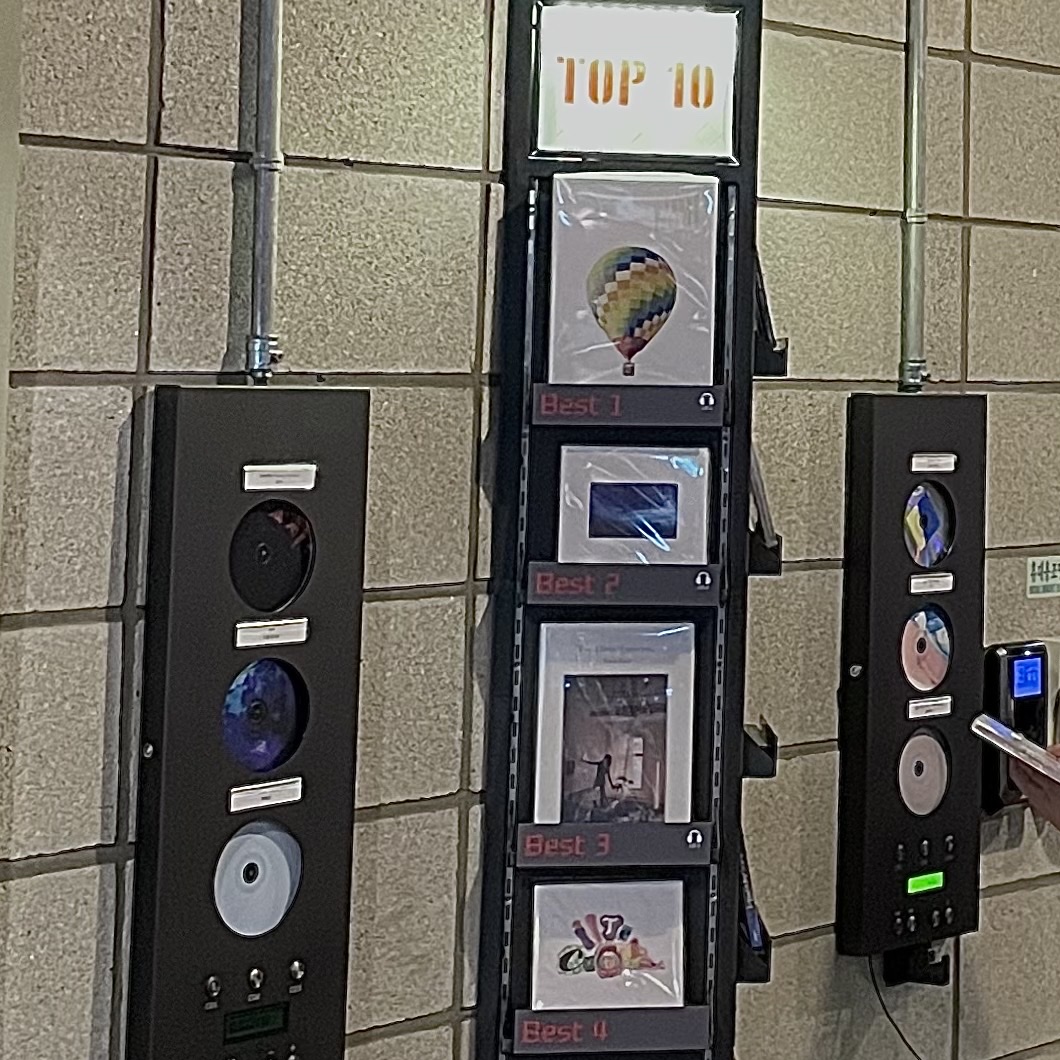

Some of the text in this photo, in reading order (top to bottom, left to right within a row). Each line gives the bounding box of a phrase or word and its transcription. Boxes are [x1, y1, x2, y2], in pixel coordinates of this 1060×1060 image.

[556, 56, 714, 109] TOP 10
[540, 392, 622, 417] Best 1
[536, 571, 621, 596] Best 2
[524, 833, 611, 857] Best 3
[520, 1018, 609, 1044] Best 4
